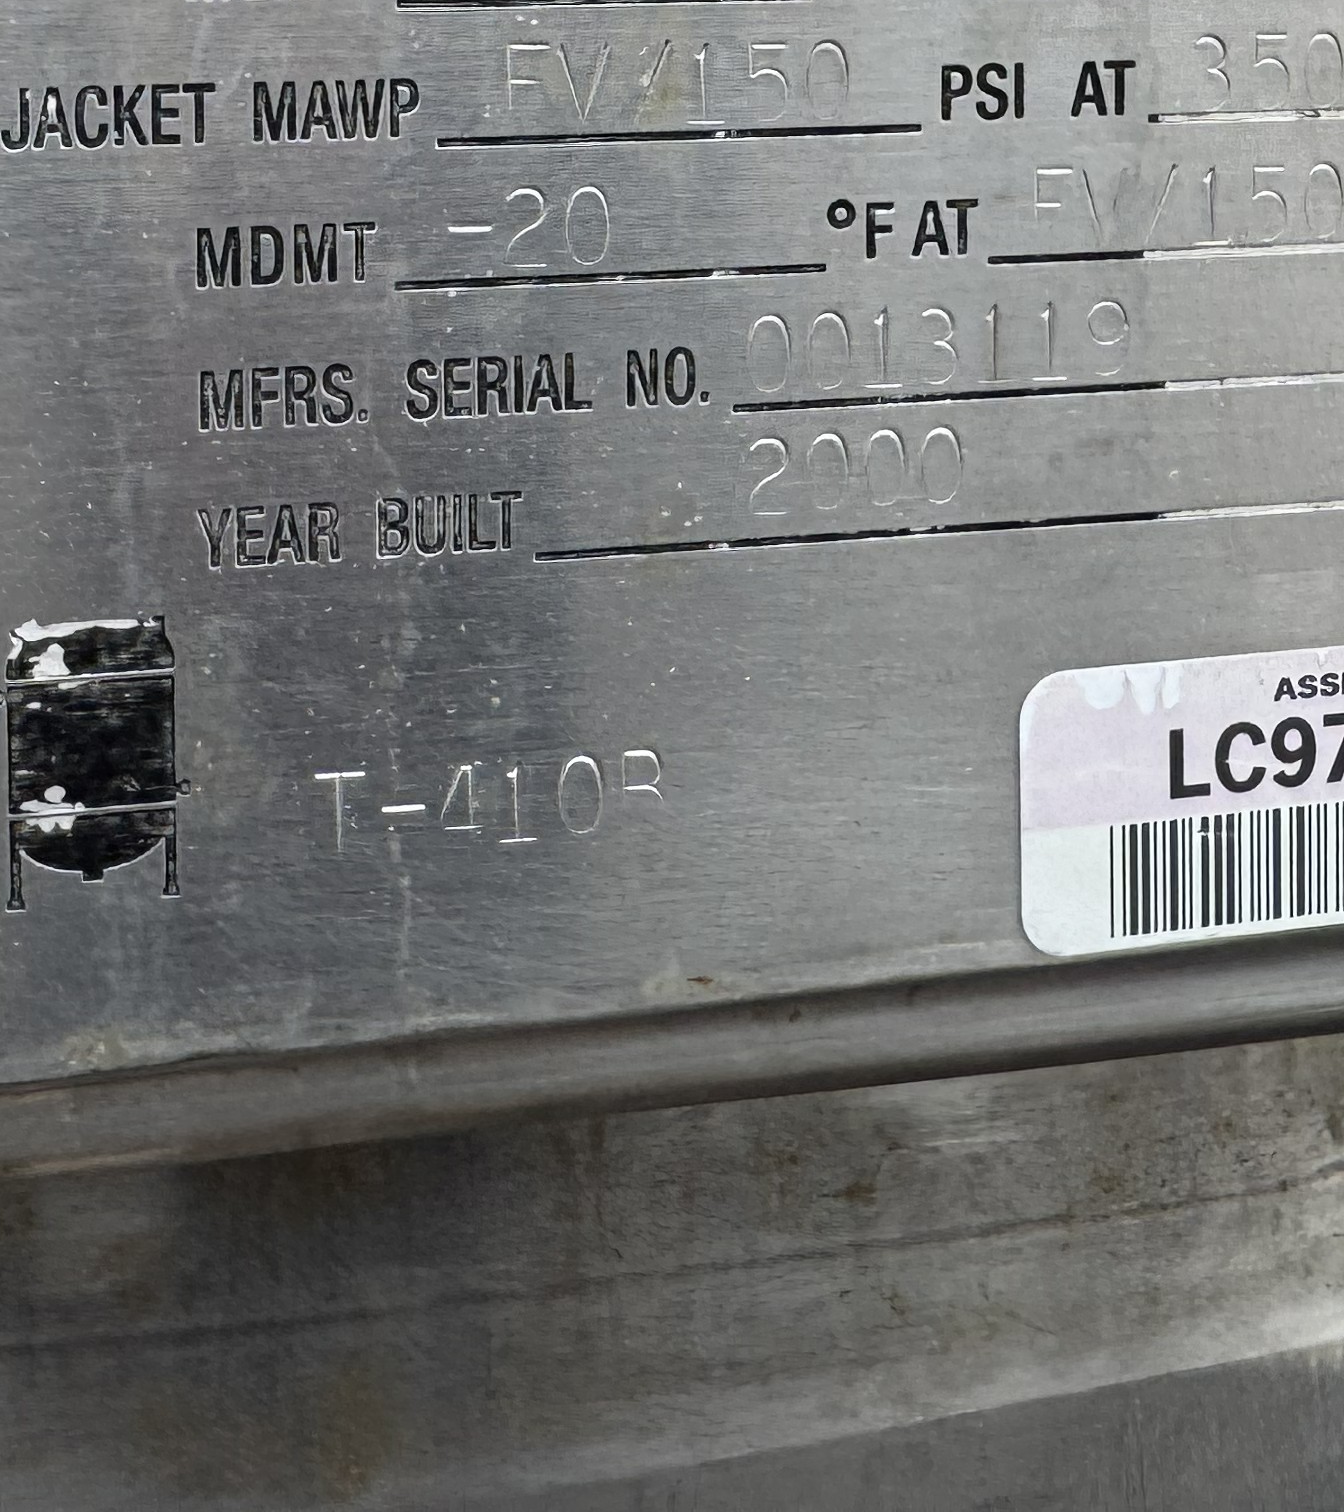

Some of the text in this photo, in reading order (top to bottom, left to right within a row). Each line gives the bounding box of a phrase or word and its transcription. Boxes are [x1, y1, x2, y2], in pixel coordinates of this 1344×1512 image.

[0, 84, 216, 150] JACKET
[253, 78, 420, 144] MAWP
[505, 40, 849, 126] FV/150
[940, 62, 1026, 121] PSI
[1070, 60, 1137, 118] AT
[1193, 32, 1343, 111] 350
[195, 220, 377, 289] MDMT
[447, 186, 610, 269] -20
[827, 198, 895, 259] °F
[911, 198, 979, 258] AT
[1034, 162, 1343, 247] FV/150
[198, 300, 1129, 433] MFRS. SERIAL NO. 0013119
[197, 426, 964, 569] YEAR BUILT 2000
